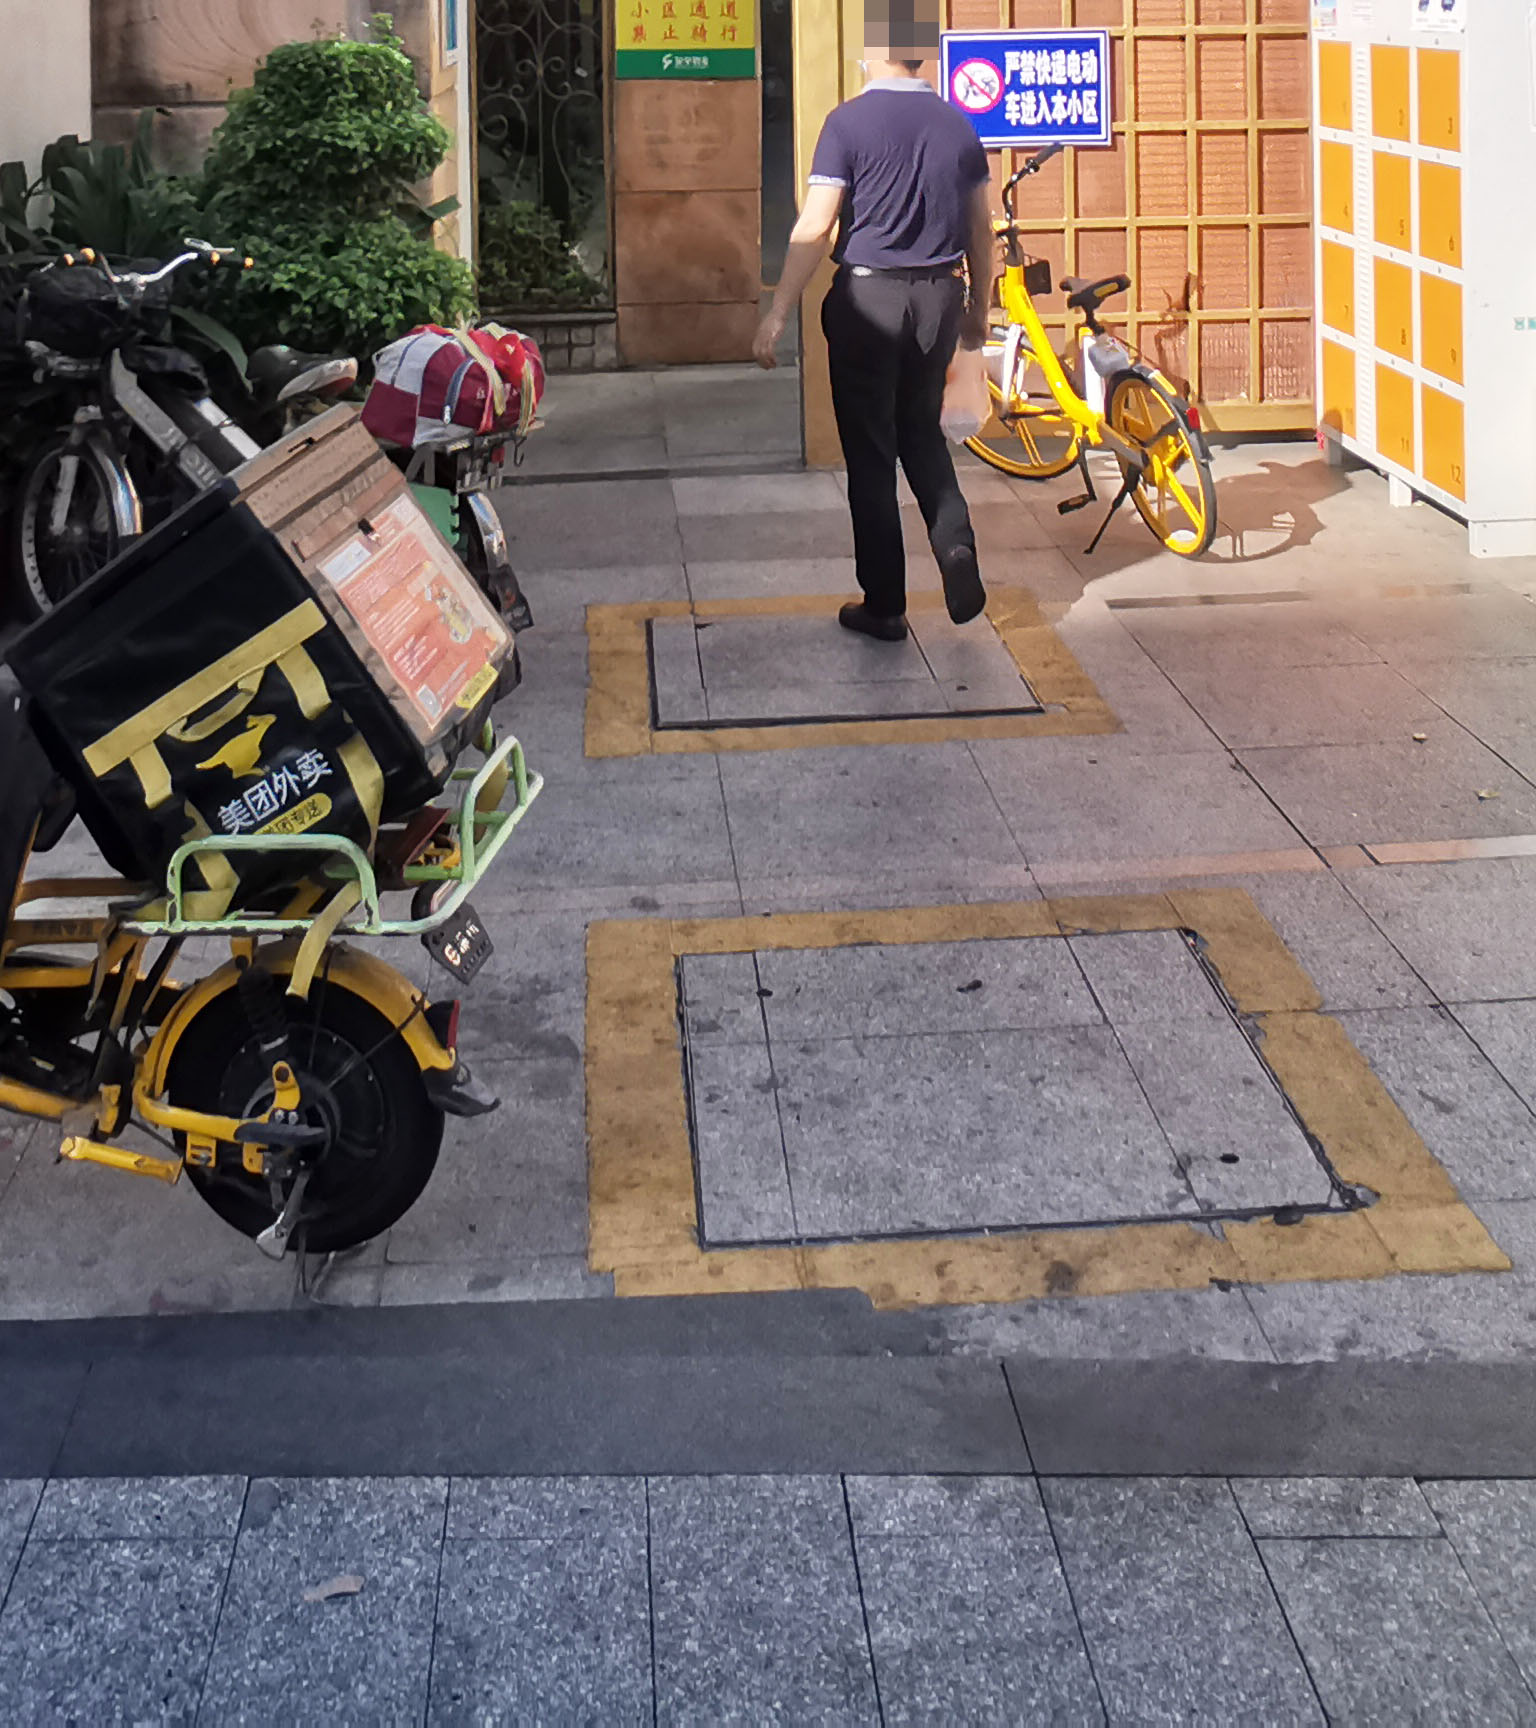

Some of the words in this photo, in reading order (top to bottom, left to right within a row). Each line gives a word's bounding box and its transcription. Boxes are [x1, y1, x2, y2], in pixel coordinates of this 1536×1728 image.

[630, 0, 740, 20] 小区通道
[1004, 48, 1098, 87] 严禁快递电动
[1004, 89, 1099, 127] 车进入本小区
[217, 748, 334, 836] 美团外卖
